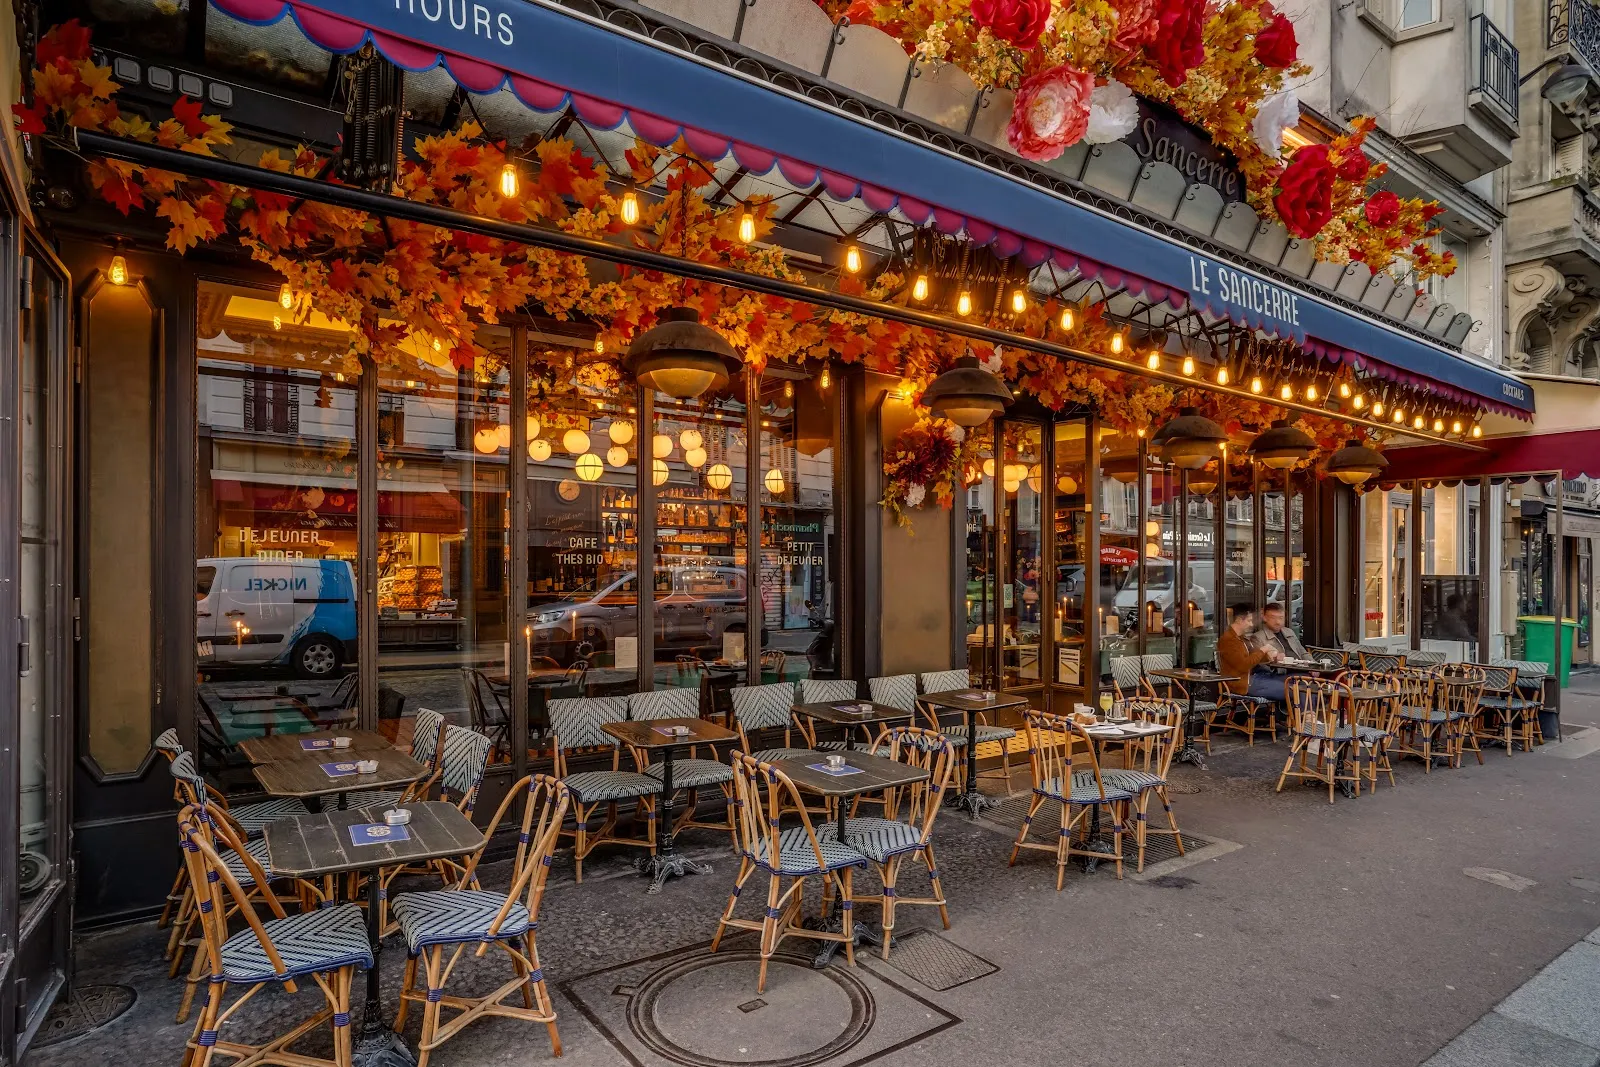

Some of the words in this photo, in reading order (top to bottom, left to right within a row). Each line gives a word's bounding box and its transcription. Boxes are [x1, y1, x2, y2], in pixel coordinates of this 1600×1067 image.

[1136, 117, 1237, 195] Sancerre
[1190, 256, 1210, 295] LE
[1218, 267, 1300, 326] SANCERRE
[1502, 382, 1525, 401] COCKTAILS
[569, 537, 598, 549] CAFE
[787, 541, 814, 552] PETIT
[258, 550, 304, 563] DINER
[556, 553, 584, 565] THES
[585, 553, 604, 565] BIO
